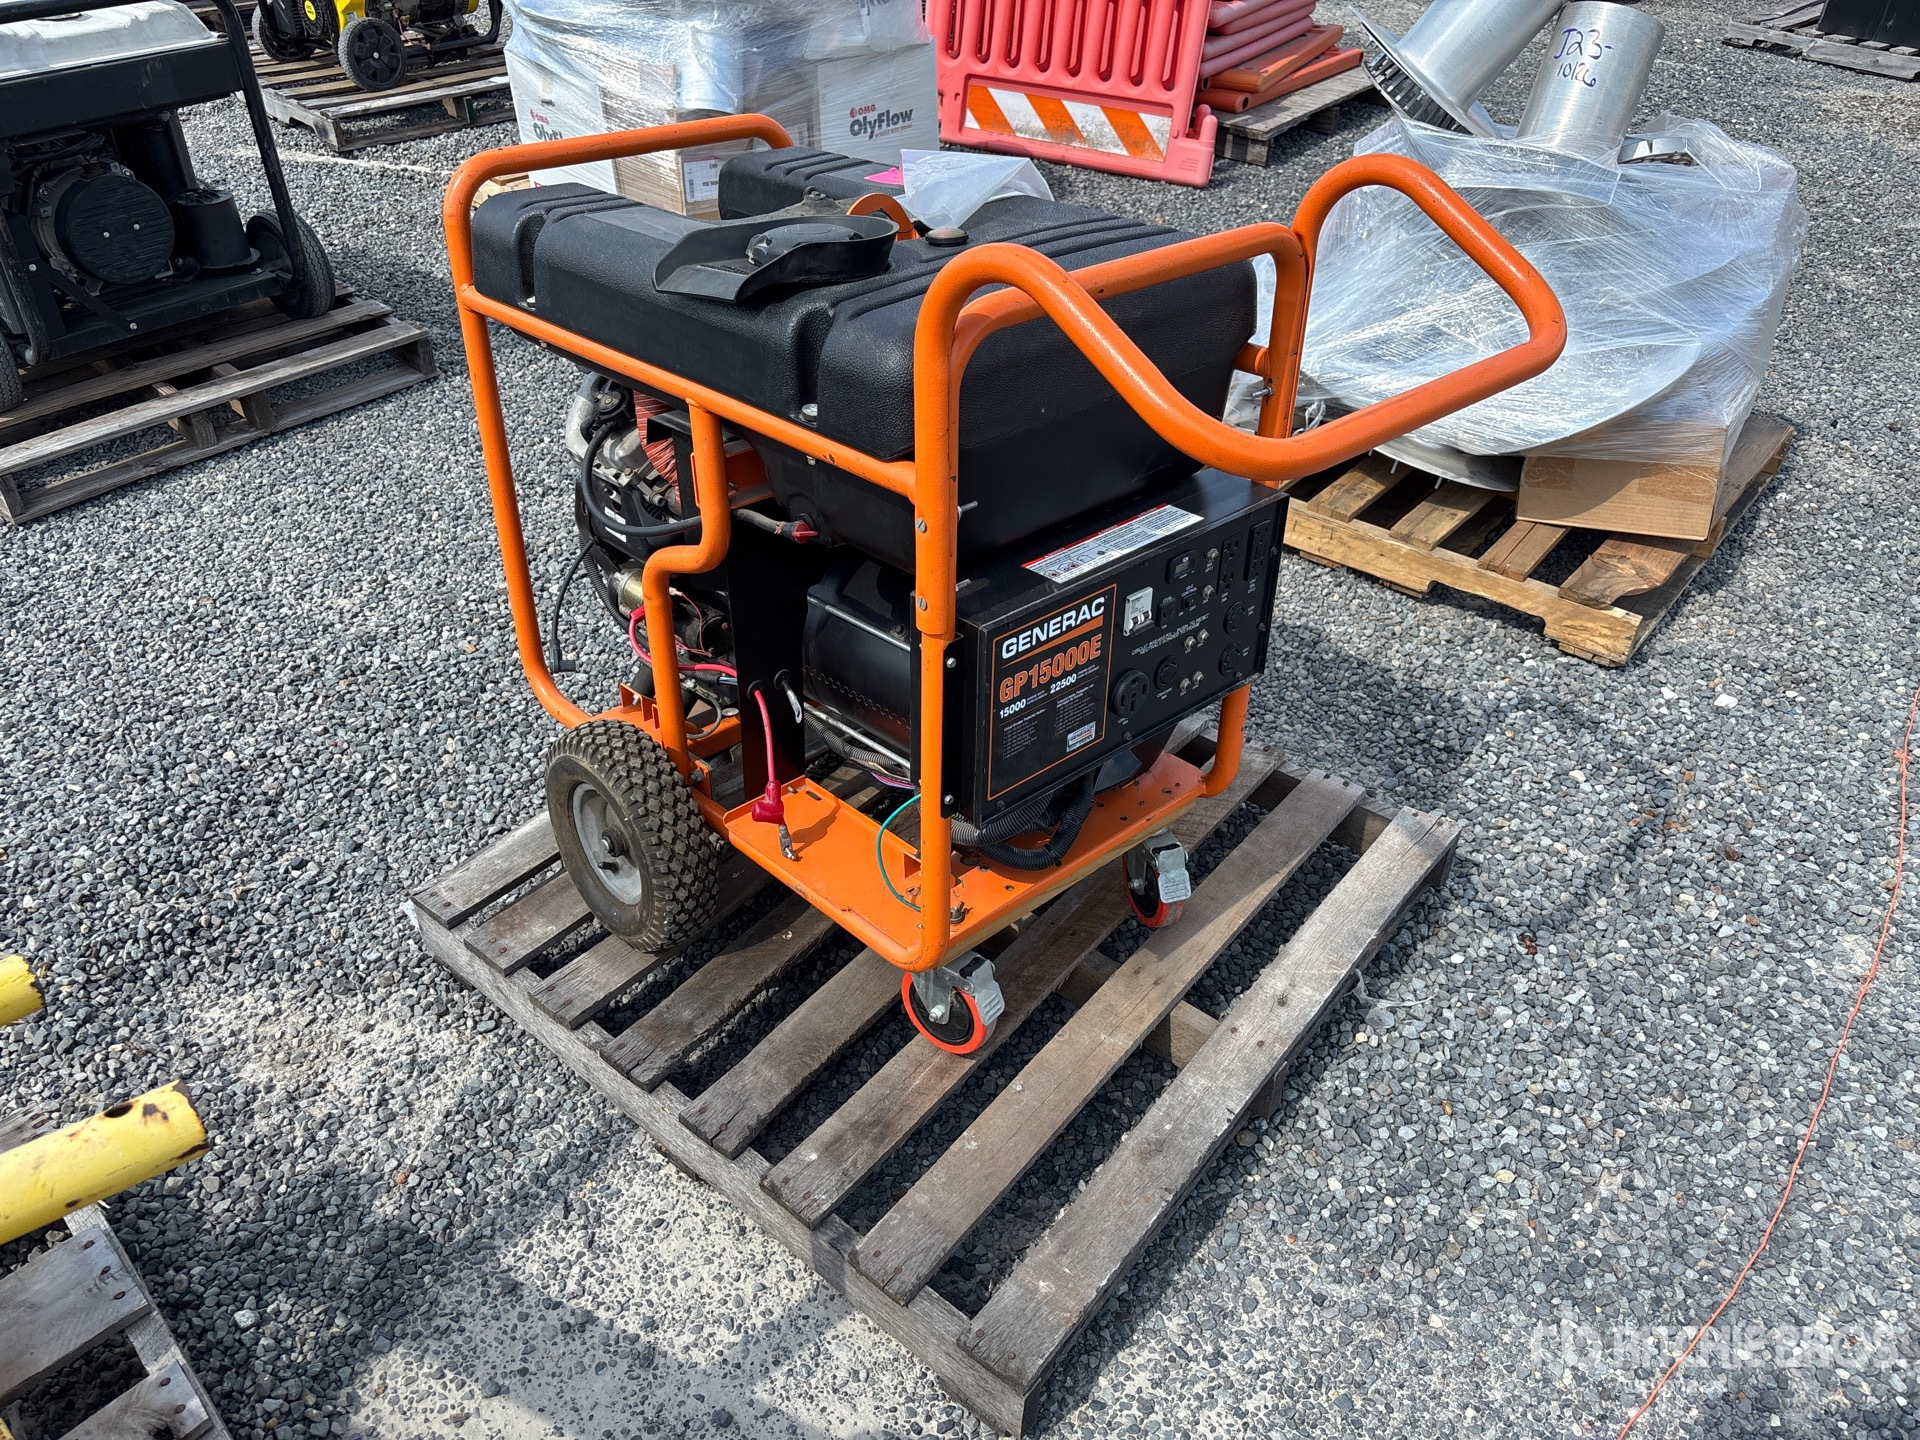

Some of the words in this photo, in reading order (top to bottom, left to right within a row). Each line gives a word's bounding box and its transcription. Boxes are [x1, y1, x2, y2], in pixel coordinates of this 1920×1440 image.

[858, 104, 876, 115] OMG
[849, 108, 913, 140] OlyFlow
[1002, 597, 1104, 659] GENERAC
[999, 633, 1102, 703] GP15000E
[1050, 673, 1077, 694] 22500
[999, 698, 1026, 719] 15000
